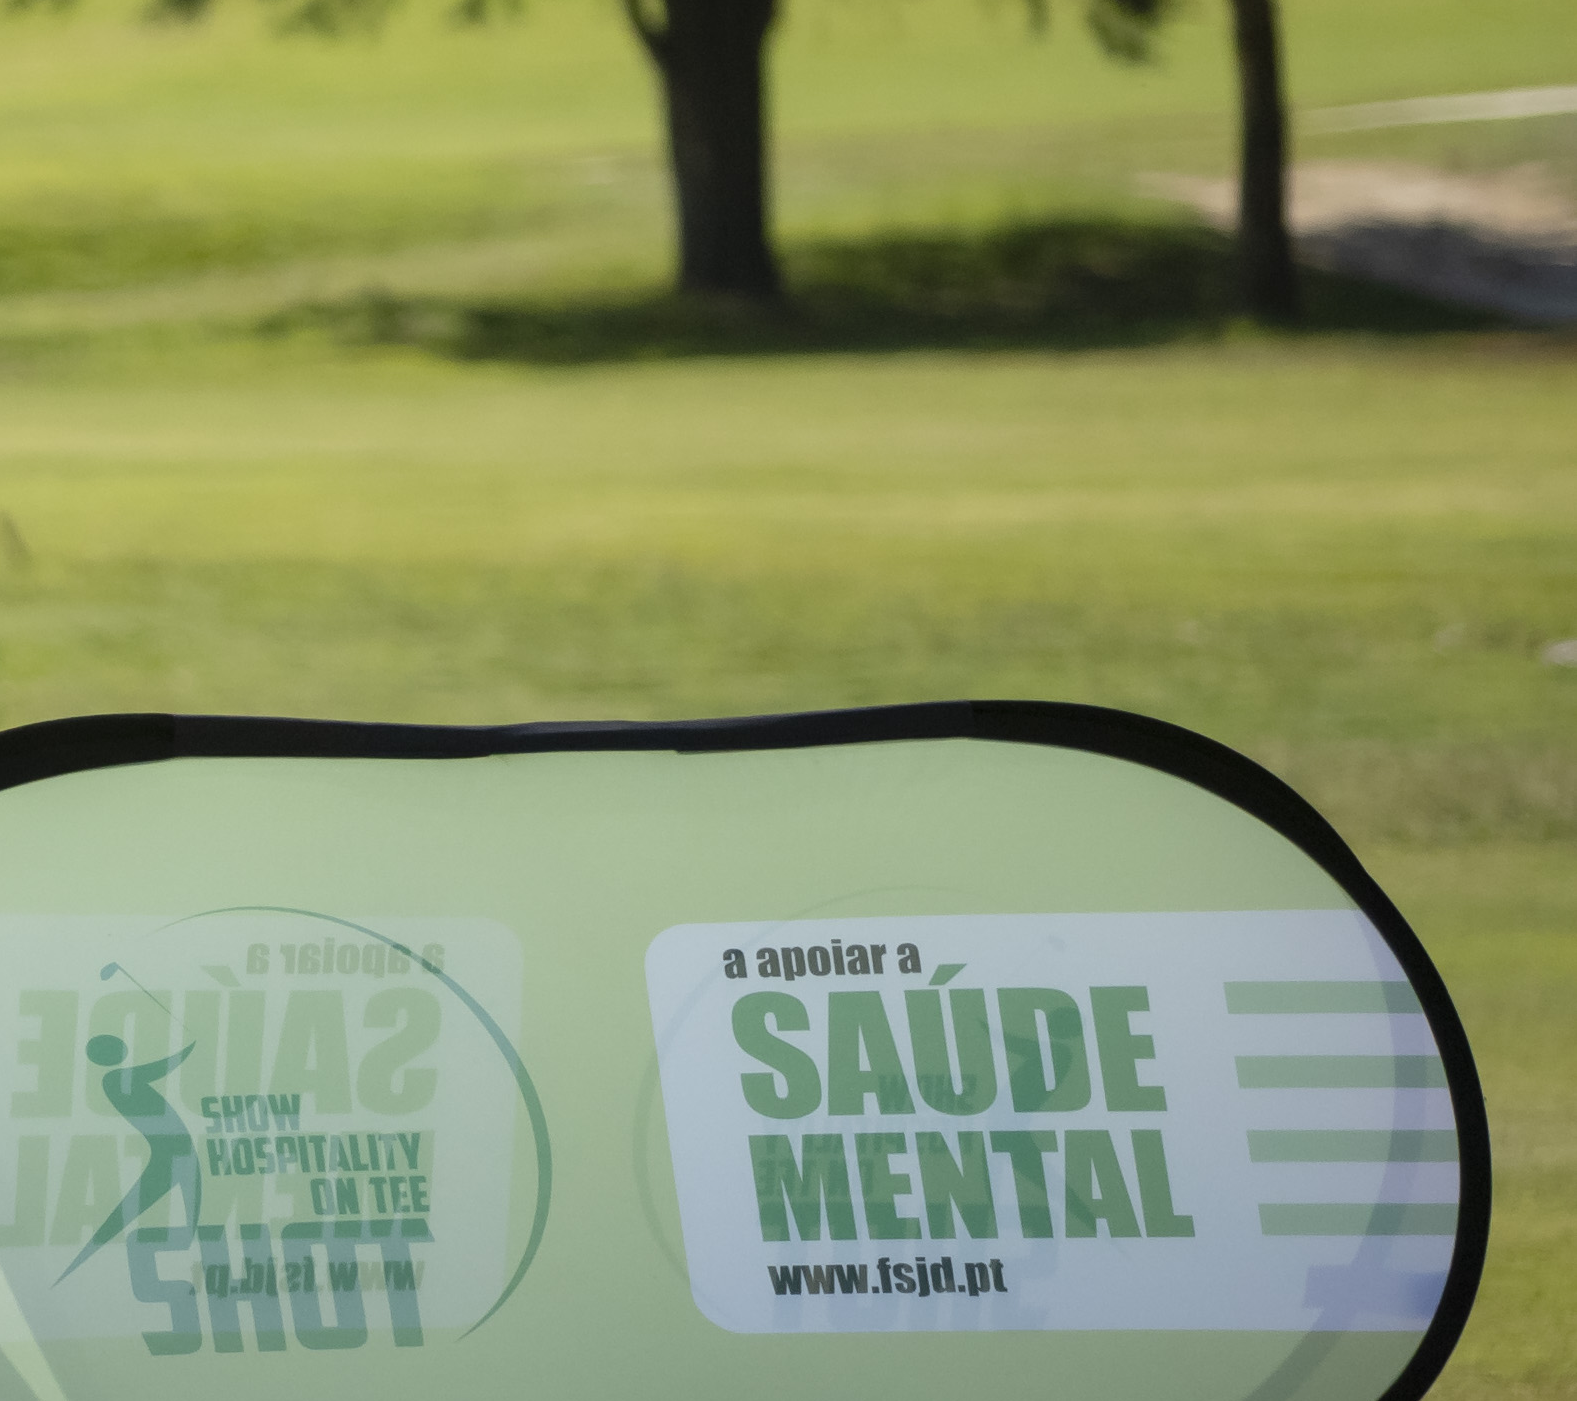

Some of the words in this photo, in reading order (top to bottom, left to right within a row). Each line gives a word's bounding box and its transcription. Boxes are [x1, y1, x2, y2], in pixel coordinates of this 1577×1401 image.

[722, 947, 747, 979] a
[756, 939, 887, 982] apoiar
[896, 943, 923, 975] a
[730, 962, 1169, 1120] SAÚDE
[200, 1094, 301, 1134] SHOW
[206, 1132, 421, 1177] HOSPITALITY
[310, 1178, 360, 1216] ON
[368, 1175, 431, 1214] TEE
[747, 1128, 1196, 1243] MENTAL
[125, 1219, 435, 1355] SHOT
[767, 1256, 1009, 1298] www.fsjd.pt
